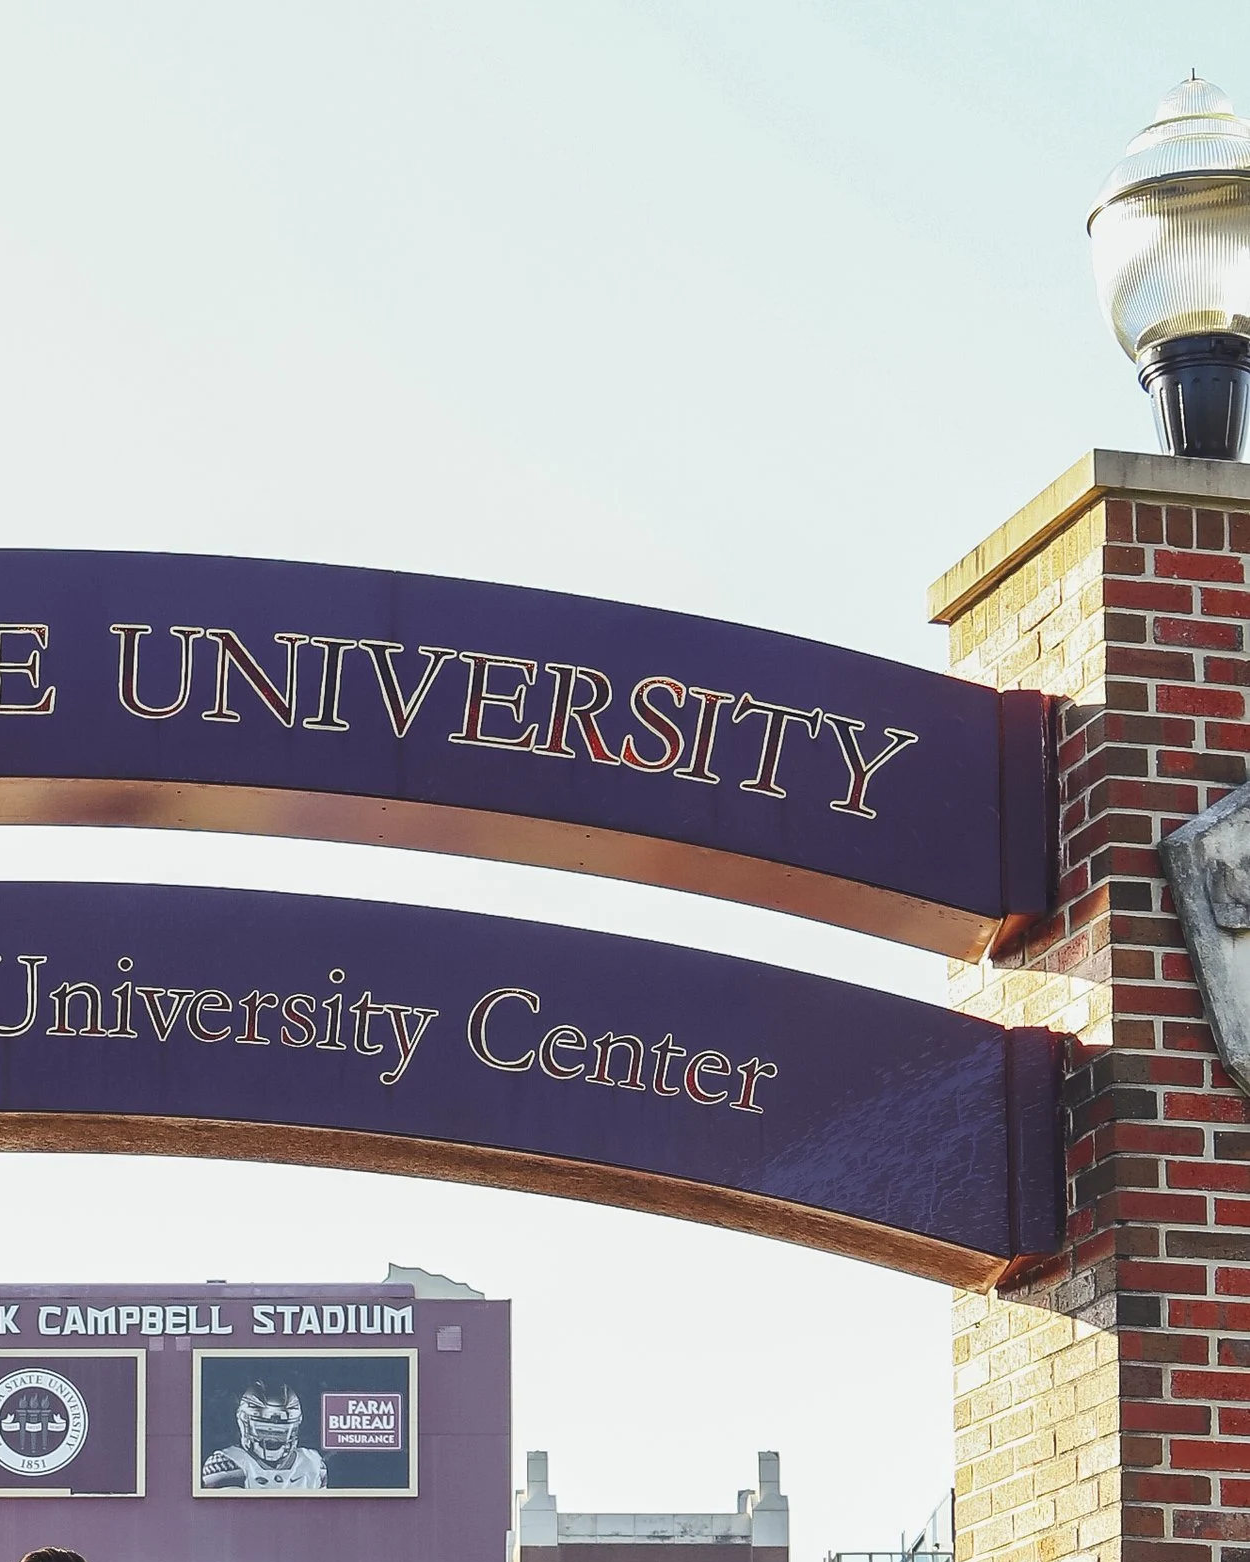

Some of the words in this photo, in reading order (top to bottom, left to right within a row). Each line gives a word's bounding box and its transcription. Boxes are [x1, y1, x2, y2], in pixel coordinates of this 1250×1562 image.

[110, 622, 919, 819] UNIVERSITY
[467, 987, 778, 1114] Center
[38, 1304, 233, 1335] CAMPBELL
[252, 1304, 415, 1335] STADIUM
[5, 1374, 43, 1393] STATE
[48, 1378, 81, 1450] UNIVERSITY
[348, 1400, 395, 1414] FARM
[329, 1415, 395, 1430] BUREAU
[337, 1434, 395, 1444] INSURANCE
[20, 1458, 47, 1470] 1851
